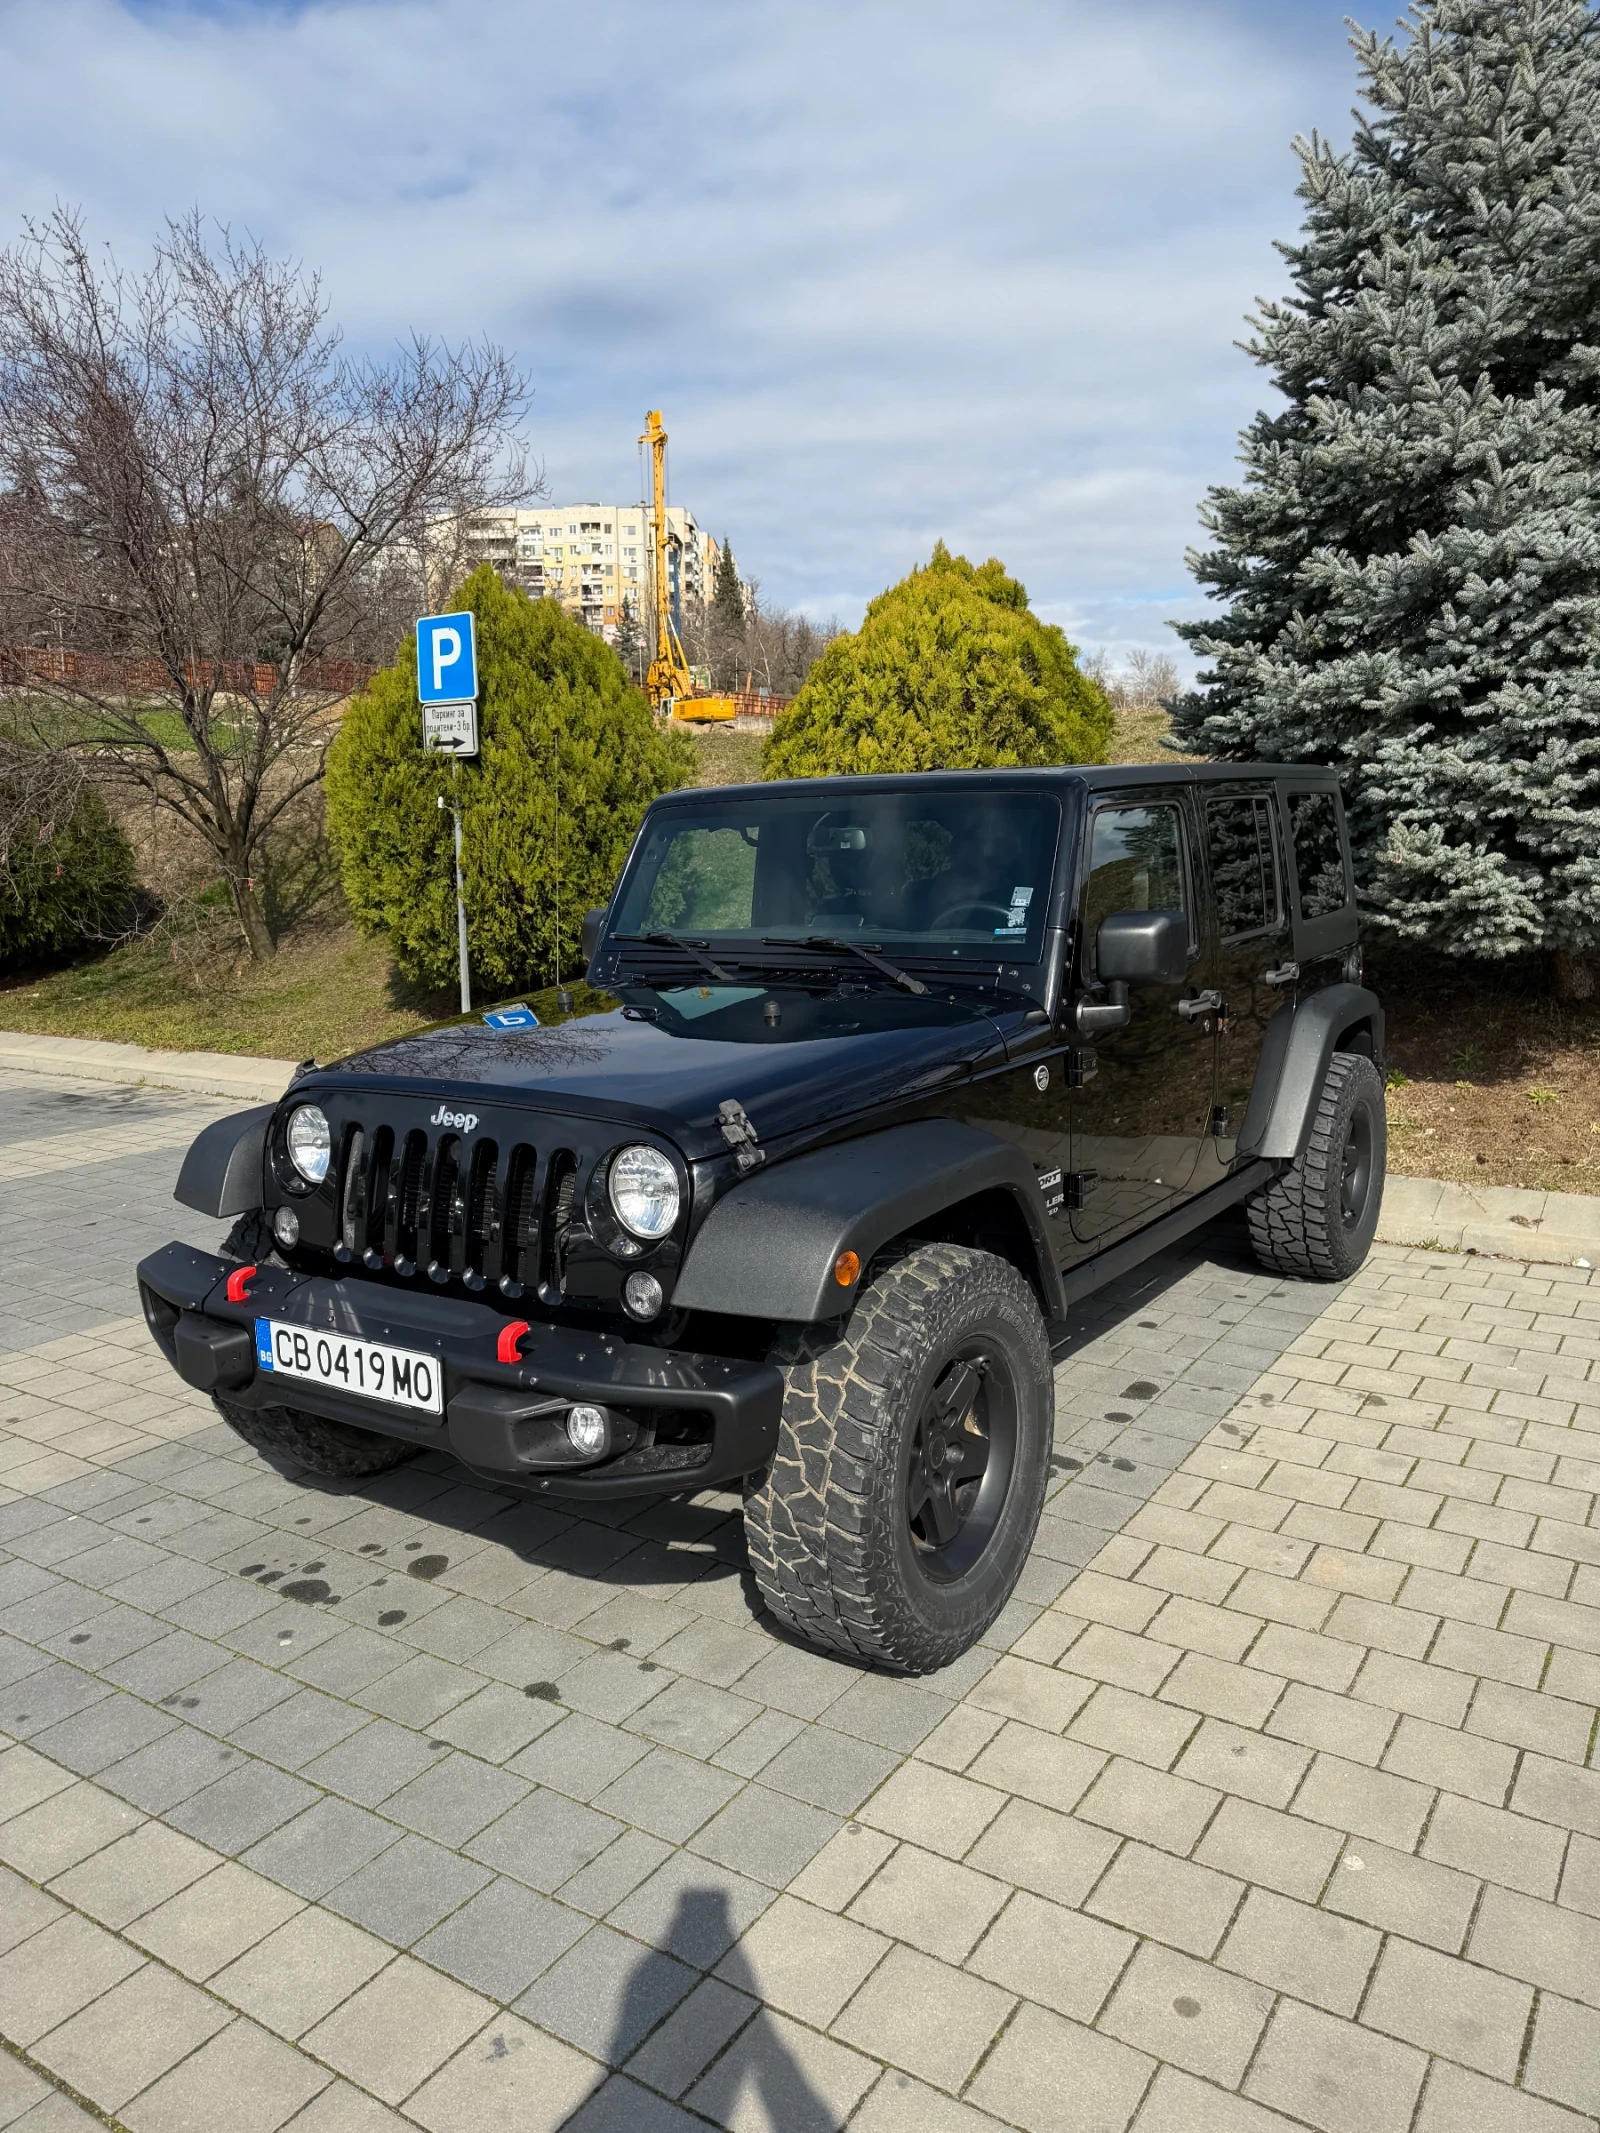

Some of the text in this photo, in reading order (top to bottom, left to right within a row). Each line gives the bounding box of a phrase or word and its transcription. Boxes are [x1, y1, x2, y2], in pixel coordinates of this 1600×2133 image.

[432, 627, 461, 690] P
[431, 709, 465, 722] Паркинг за
[430, 1105, 478, 1133] Jeep
[260, 1350, 273, 1363] BG
[275, 1329, 433, 1402] CB 0419 MO
[997, 1302, 1044, 1386] THOMPSON
